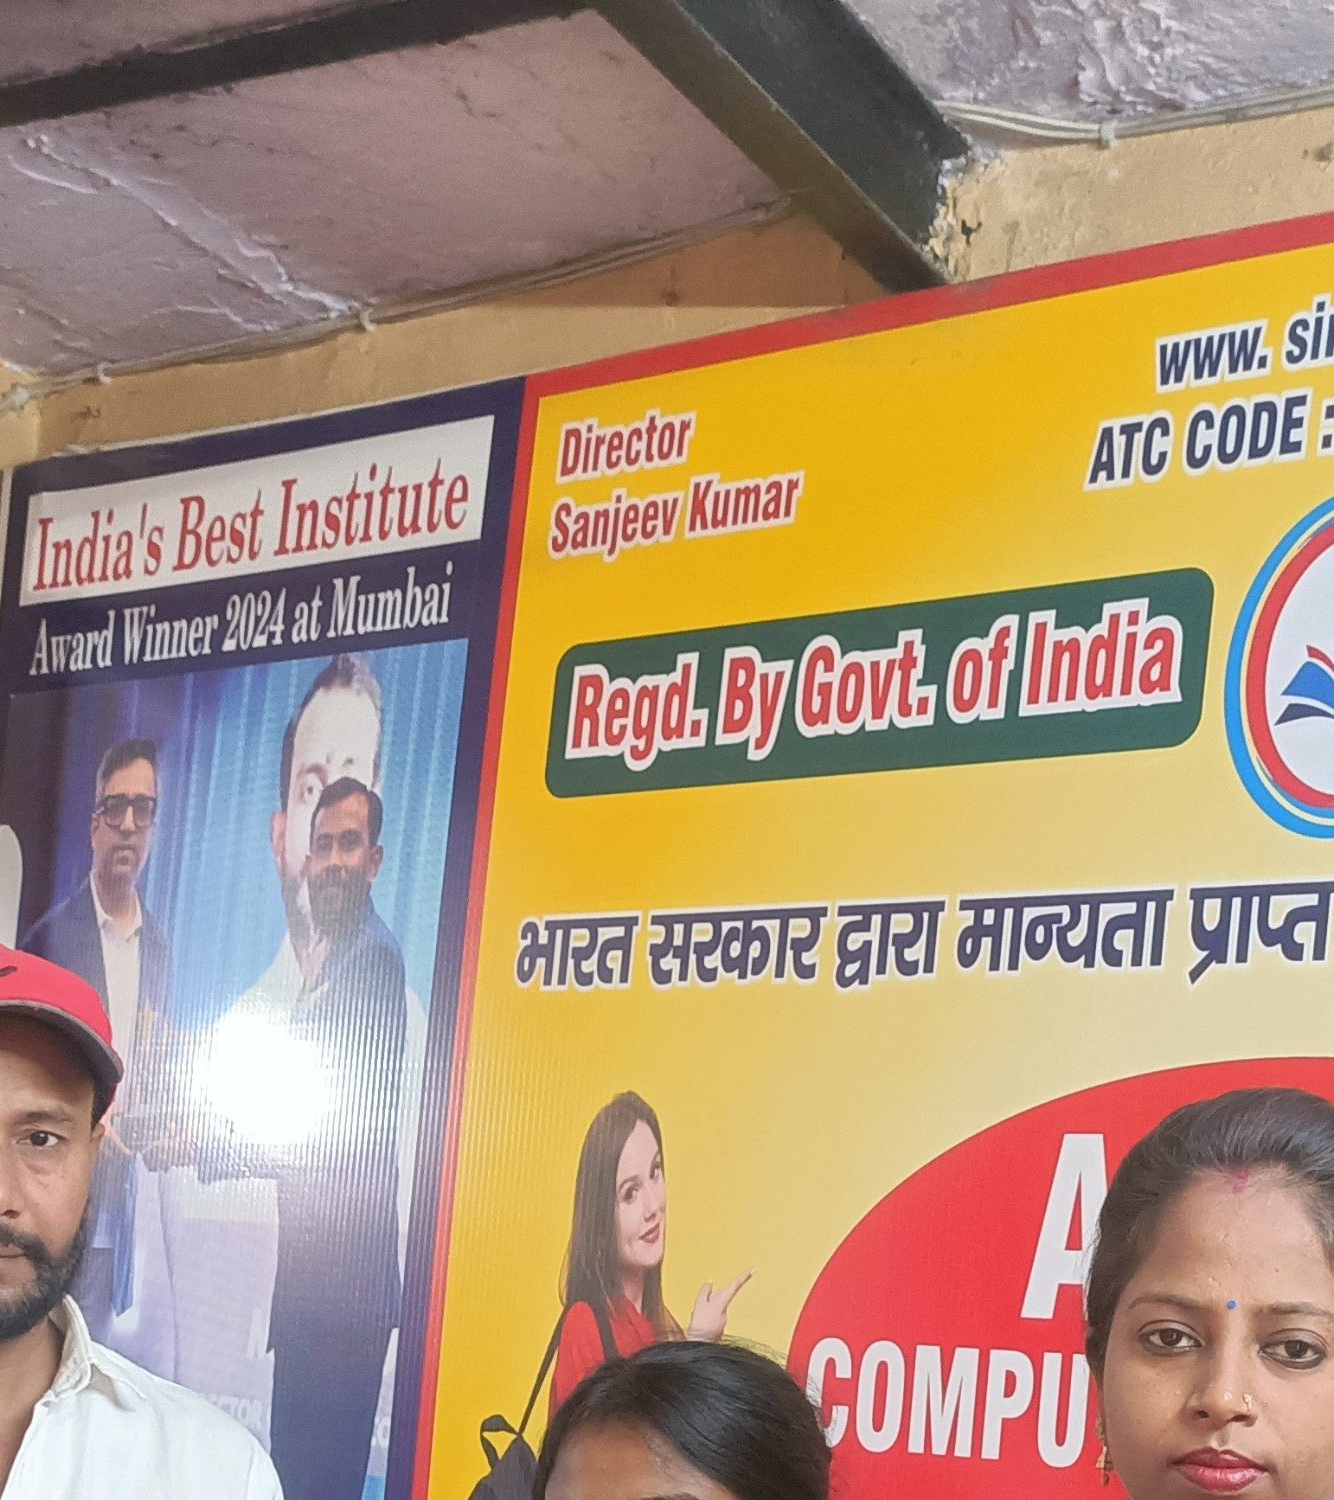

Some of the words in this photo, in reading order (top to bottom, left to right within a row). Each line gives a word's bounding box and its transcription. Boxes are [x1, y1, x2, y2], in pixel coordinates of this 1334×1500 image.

[1156, 327, 1269, 390] www.
[561, 413, 693, 478] Director
[1088, 415, 1170, 485] ATC
[1184, 400, 1304, 471] CODE
[33, 505, 165, 591] India's
[172, 493, 265, 571] Best
[274, 457, 469, 557] Institute
[551, 487, 678, 557] Sanjeev
[688, 472, 801, 534] Kumar
[29, 610, 113, 676] Award
[121, 602, 219, 663] Winner
[222, 588, 285, 651] 2024
[291, 594, 322, 644] at
[327, 562, 454, 638] Mumbai
[569, 665, 703, 764] Regd.
[720, 652, 785, 755] By
[798, 632, 933, 735] Govt.
[953, 613, 1013, 715] of
[1026, 602, 1177, 708] India
[519, 914, 639, 985] भारत
[649, 905, 828, 985] सरकार
[835, 899, 944, 986] द्वारा
[955, 888, 1173, 974] मान्यता
[809, 1339, 1088, 1469] COMPU
